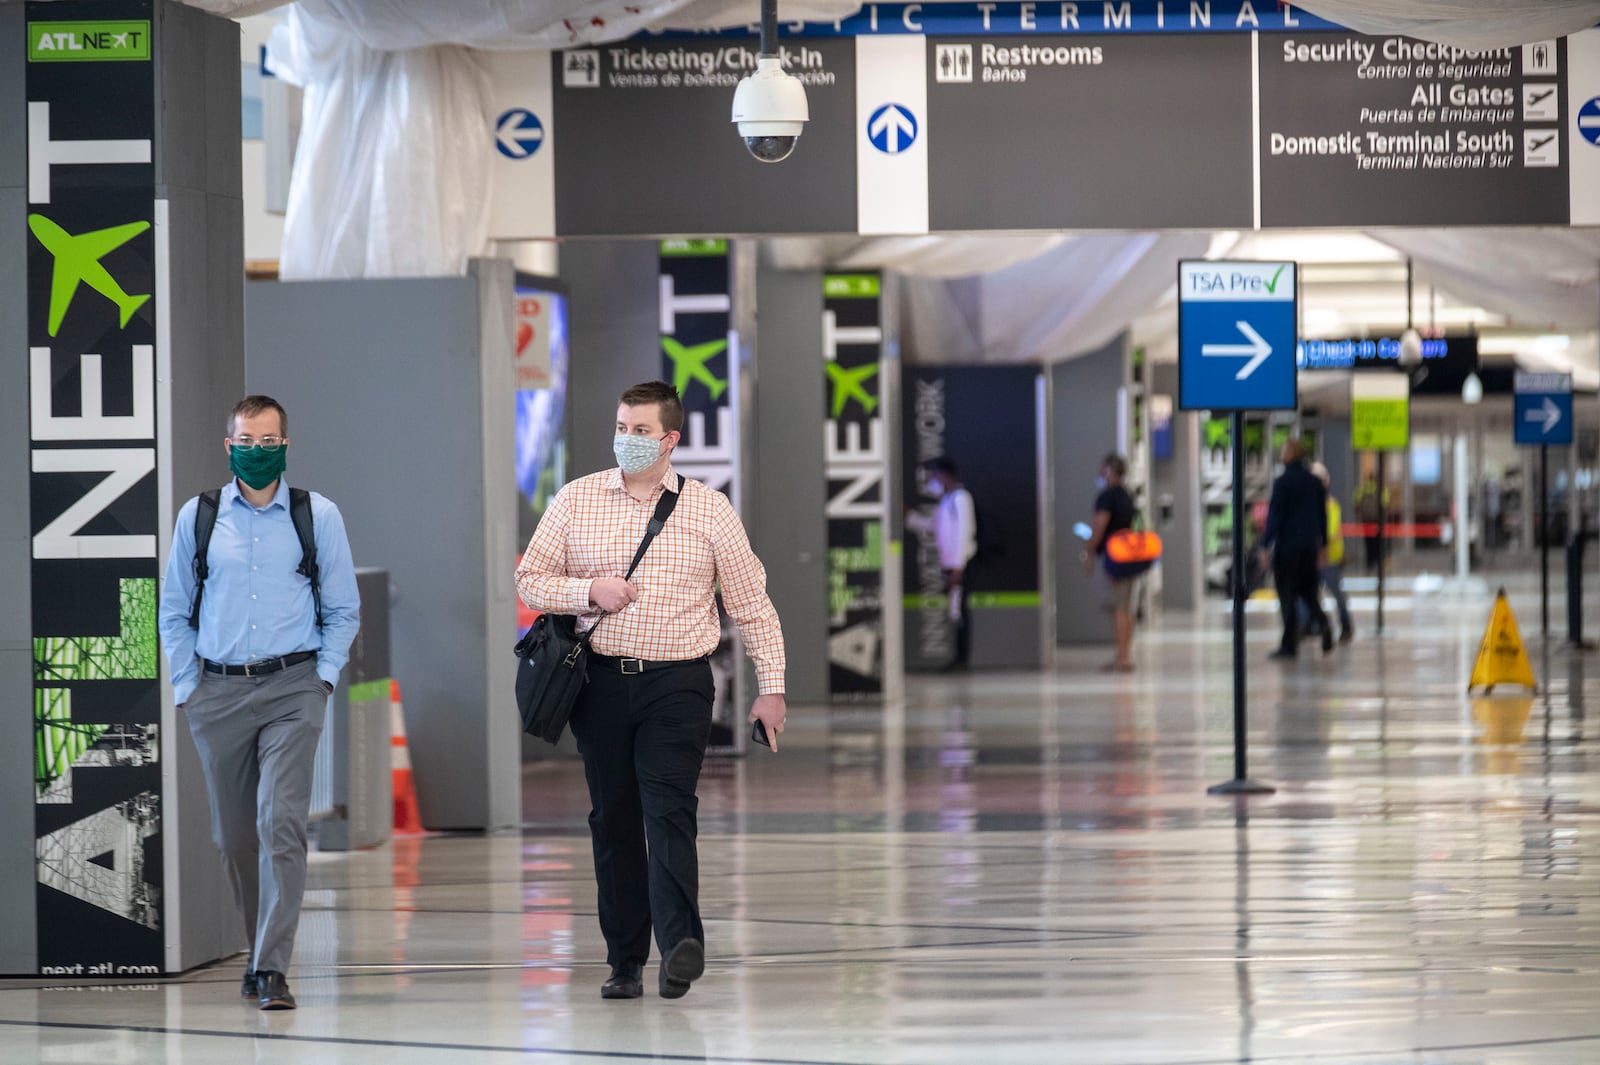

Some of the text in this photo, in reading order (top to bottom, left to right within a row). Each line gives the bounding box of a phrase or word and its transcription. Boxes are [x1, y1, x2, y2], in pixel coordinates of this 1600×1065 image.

[977, 2, 1299, 30] TERMINAL
[608, 46, 823, 74] Ticketing/Chk-In
[981, 43, 1104, 66] Restrooms
[1283, 38, 1375, 65] Security
[608, 72, 659, 87] Ventas
[661, 71, 681, 87] de
[982, 66, 1027, 83] Baños
[1356, 61, 1512, 81] Control de Seguridad
[1410, 83, 1514, 106] All Gates
[1360, 106, 1514, 125] Puertas de Embarque
[1270, 129, 1514, 155] Domestic Terminal South
[1356, 152, 1514, 170] Terminal Nacional Sur
[1189, 272, 1225, 293] TSA
